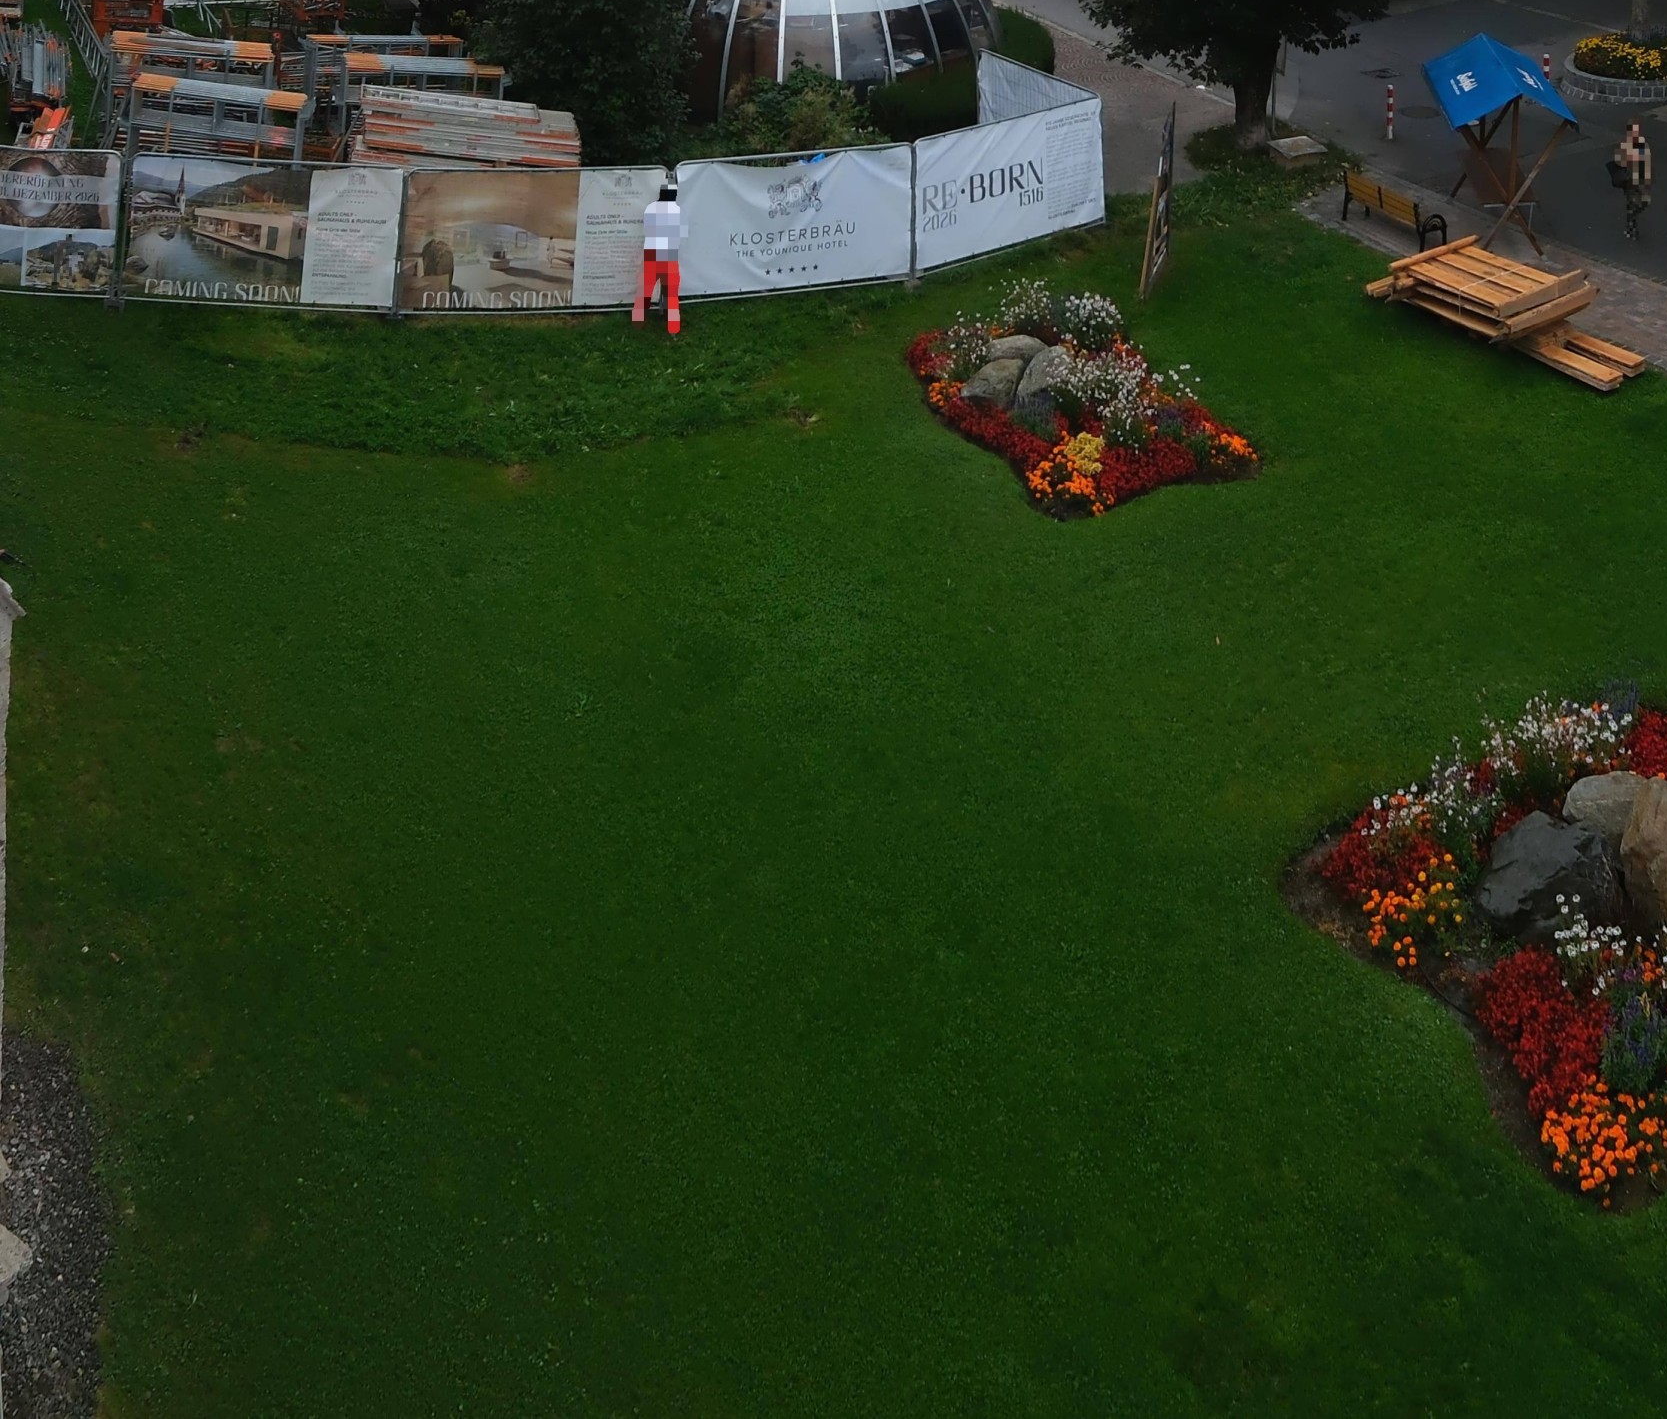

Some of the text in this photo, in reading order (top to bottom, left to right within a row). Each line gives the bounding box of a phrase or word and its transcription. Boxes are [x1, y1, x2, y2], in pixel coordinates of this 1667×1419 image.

[13, 187, 71, 201] DEZEMBER
[1019, 186, 1043, 207] 1516
[730, 220, 856, 246] KLOSTERBRÄU
[736, 240, 848, 258] THE YOUNIQUE HOTEL
[423, 290, 571, 308] COMING SOON!
